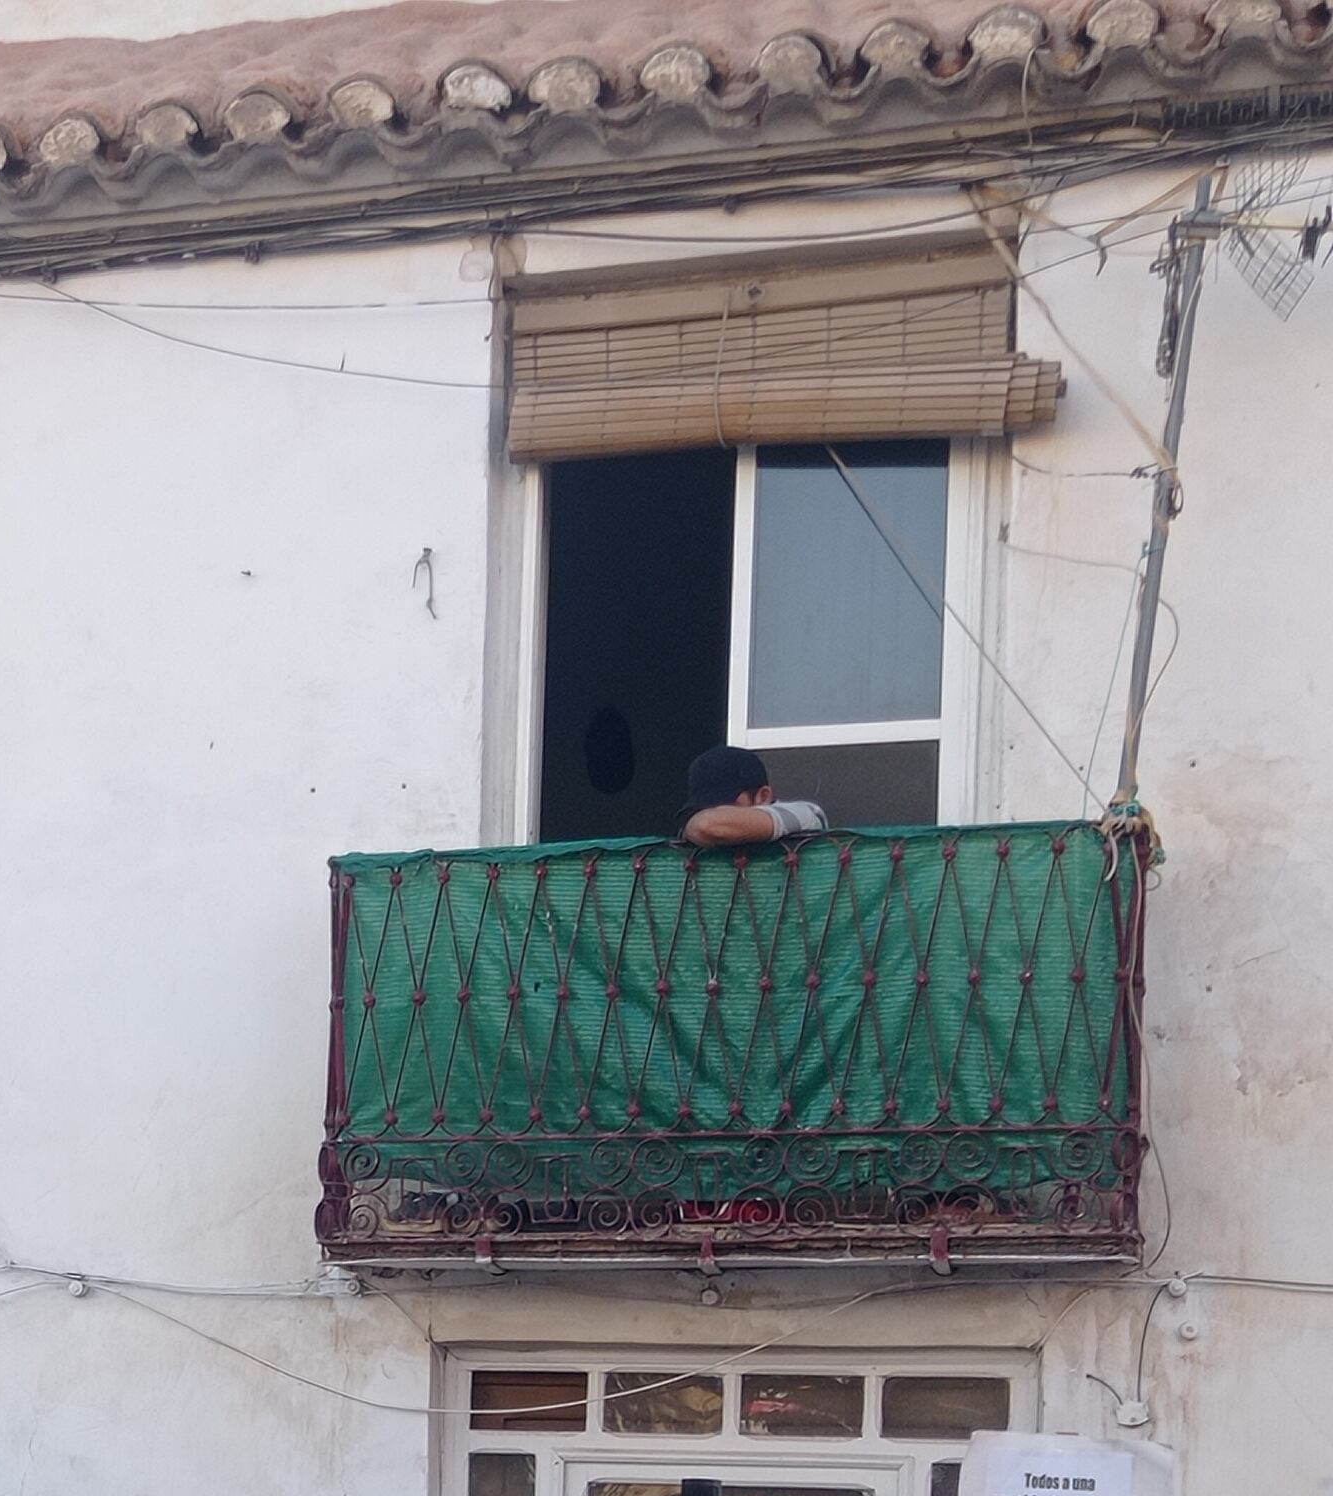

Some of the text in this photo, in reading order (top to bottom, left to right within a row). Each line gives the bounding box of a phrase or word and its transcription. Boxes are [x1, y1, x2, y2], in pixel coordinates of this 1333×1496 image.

[1025, 1472, 1096, 1491] Todos a una
